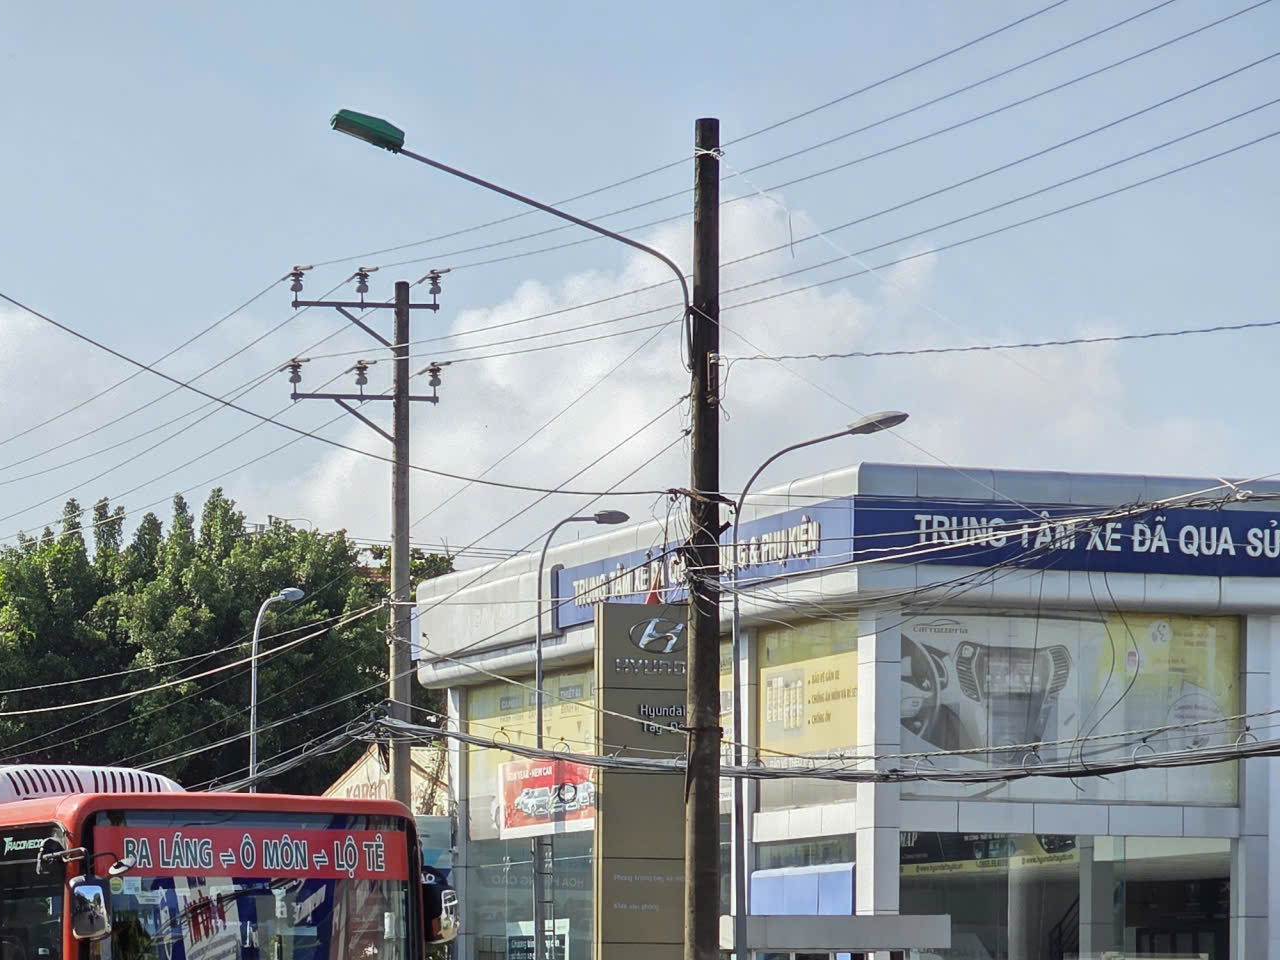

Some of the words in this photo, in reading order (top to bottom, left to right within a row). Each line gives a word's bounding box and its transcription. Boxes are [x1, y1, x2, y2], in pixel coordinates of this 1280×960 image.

[914, 513, 1007, 549] TRUNG
[1021, 510, 1077, 551] TÂM
[1087, 522, 1122, 551] XE
[1132, 515, 1169, 554] ĐÃ
[1179, 524, 1236, 557] QUA
[573, 573, 607, 607] TRUNG
[609, 562, 631, 600] TÂM
[633, 567, 649, 593] XE
[761, 531, 787, 568] PHỤ
[787, 514, 821, 563] KIỆN
[616, 658, 686, 675] HYUND
[640, 704, 686, 718] Hyundai
[123, 836, 154, 868] BA
[159, 831, 214, 869] LÁNG
[239, 832, 256, 870] Ô
[262, 833, 309, 871] MÔN
[333, 834, 360, 879] LỘ
[362, 832, 386, 872] TẺ
